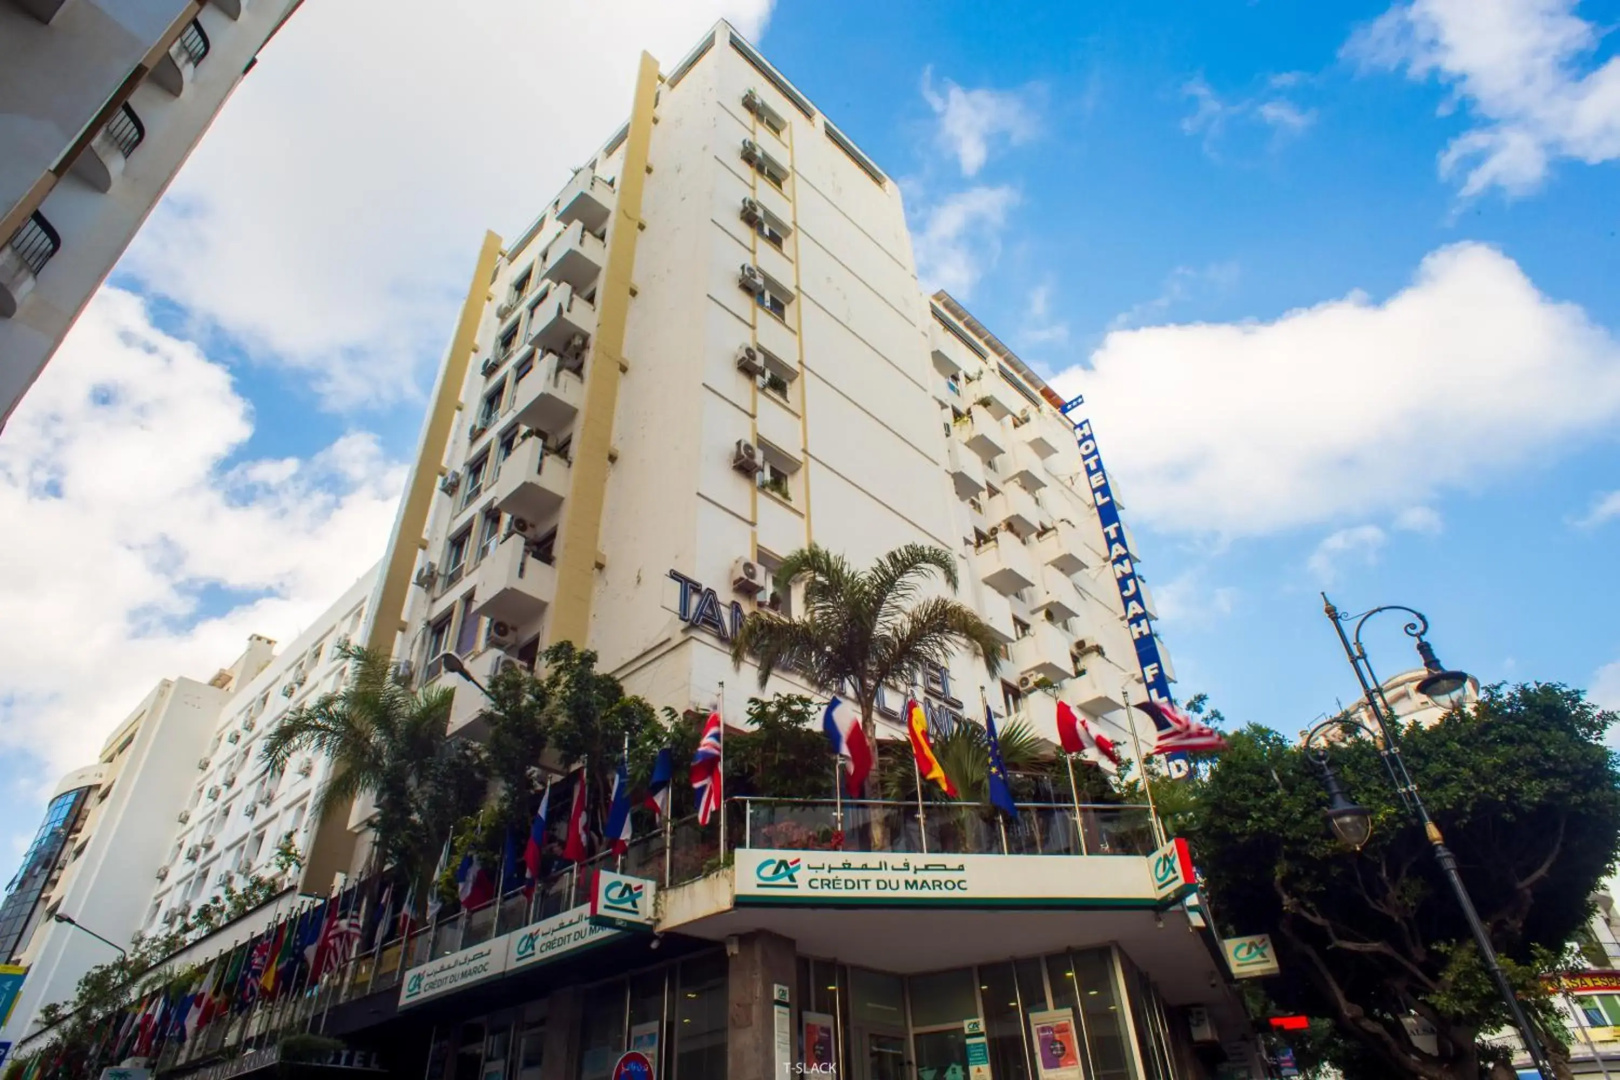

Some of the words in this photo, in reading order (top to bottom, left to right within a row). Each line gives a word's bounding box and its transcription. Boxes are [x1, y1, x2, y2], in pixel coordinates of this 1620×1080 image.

[1074, 422, 1110, 507] HOTEL
[1104, 522, 1150, 640] TANJAH
[807, 859, 888, 874] المغرب
[891, 858, 965, 874] مصرف
[808, 875, 871, 890] CRÉDIT
[876, 879, 900, 891] DU
[905, 879, 968, 891] MAROC
[540, 932, 573, 954] CRÉDIT
[573, 927, 588, 942] DU
[449, 972, 460, 984] DU
[460, 961, 490, 979] MAROC
